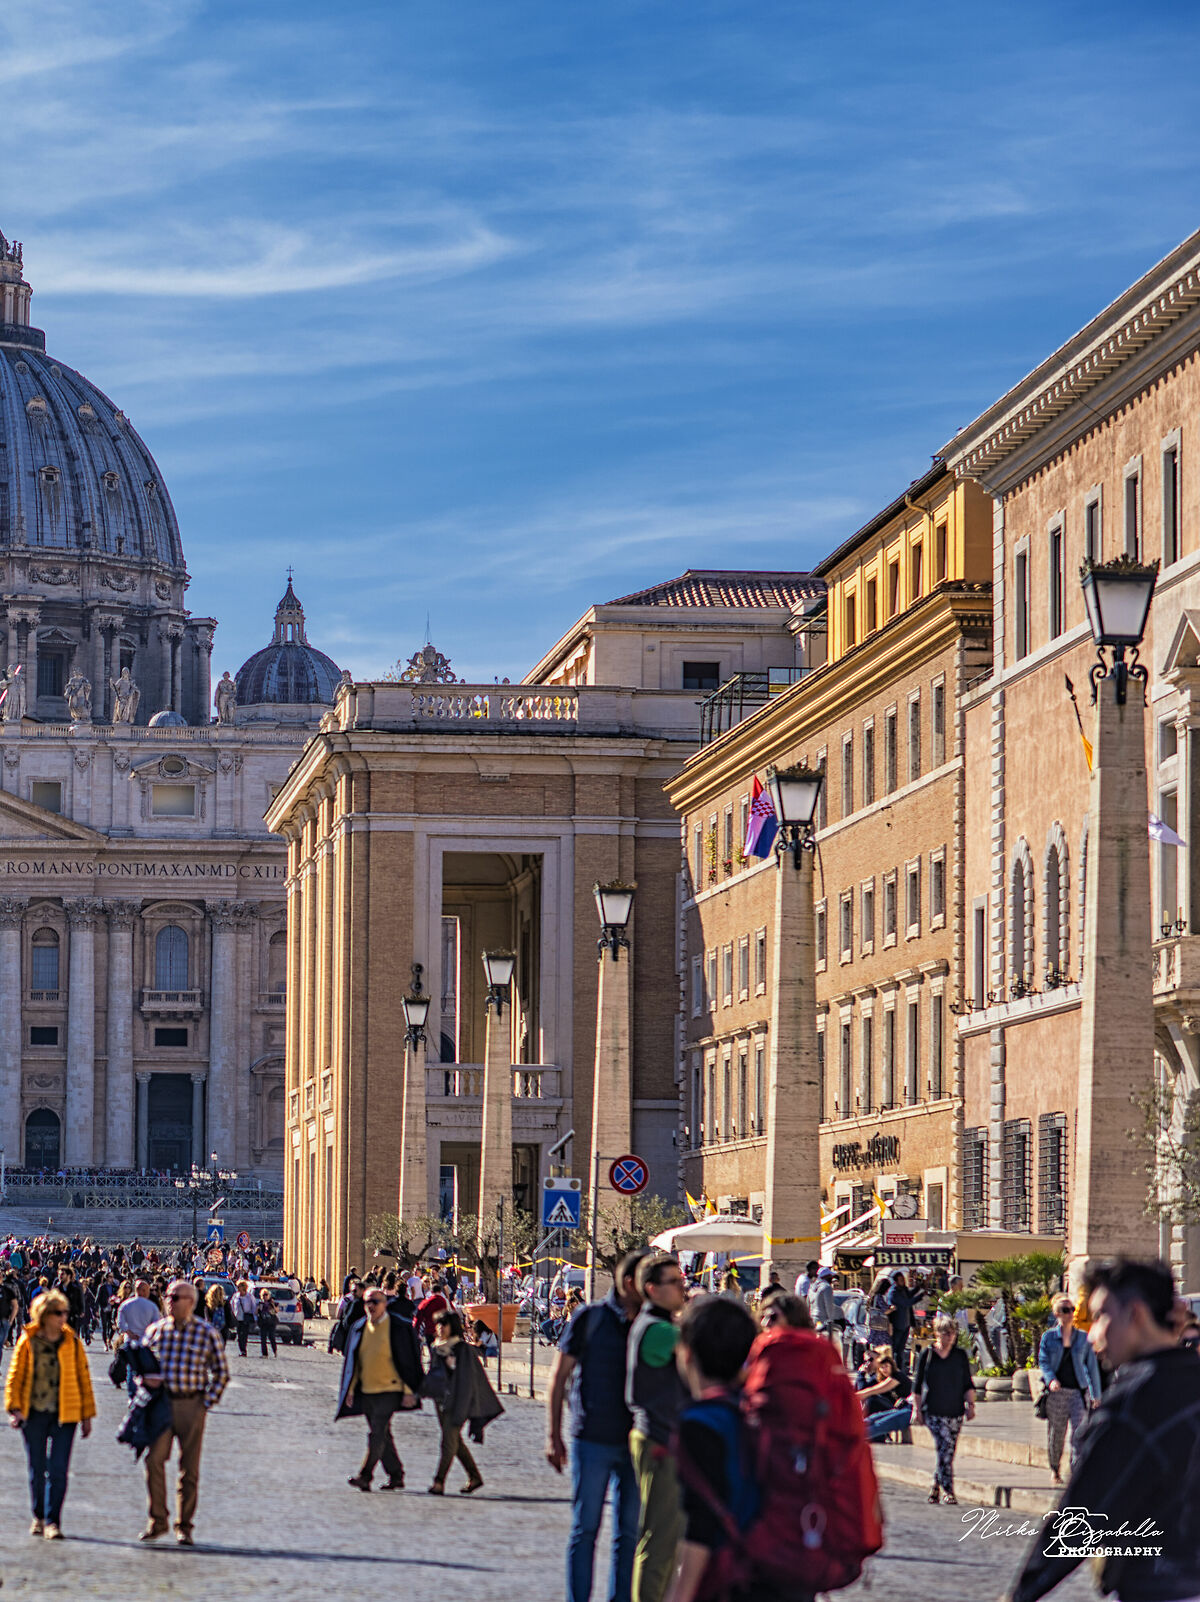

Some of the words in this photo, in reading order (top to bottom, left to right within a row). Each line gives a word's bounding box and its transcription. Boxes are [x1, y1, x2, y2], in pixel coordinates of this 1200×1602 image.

[6, 861, 94, 874] ROMANVS
[209, 864, 277, 878] MDCXII
[876, 1252, 949, 1265] BIBITE
